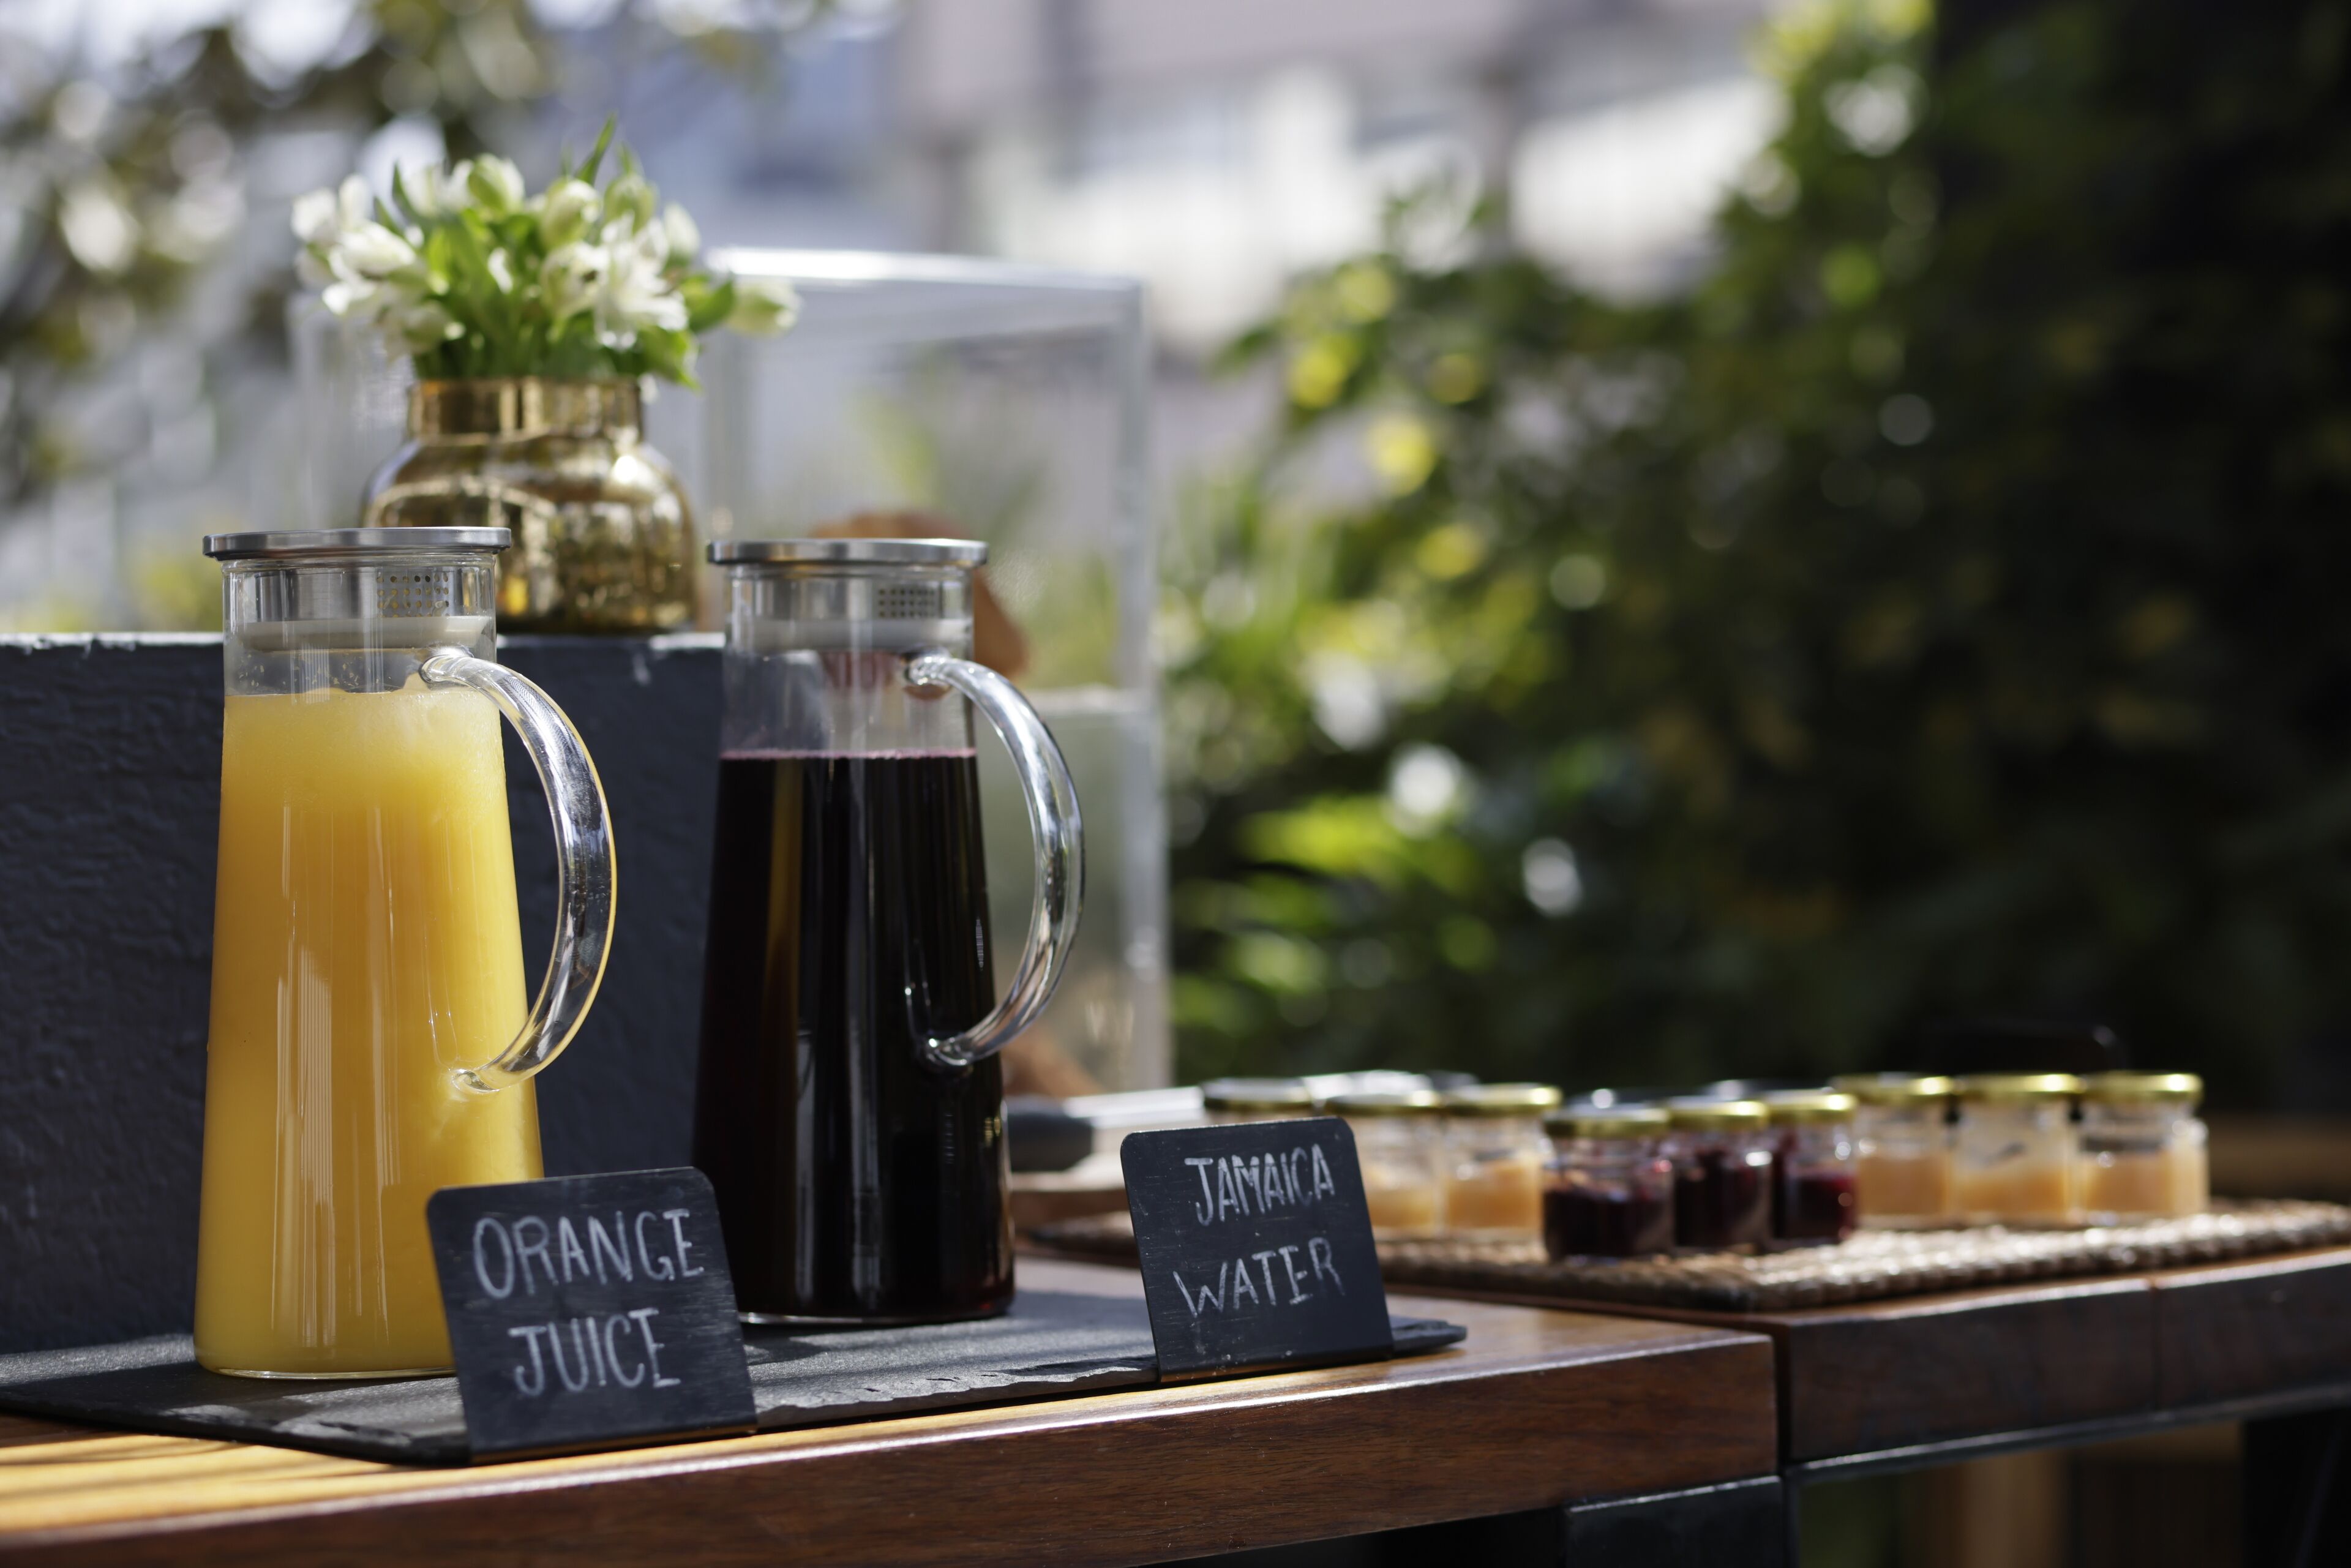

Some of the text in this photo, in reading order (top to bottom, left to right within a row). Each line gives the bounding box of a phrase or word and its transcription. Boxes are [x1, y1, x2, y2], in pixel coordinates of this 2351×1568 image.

[1185, 1143, 1335, 1226] JAMAICA
[473, 1208, 704, 1299] ORANGE
[1173, 1237, 1345, 1318] WATER
[508, 1308, 681, 1397] JUICE
